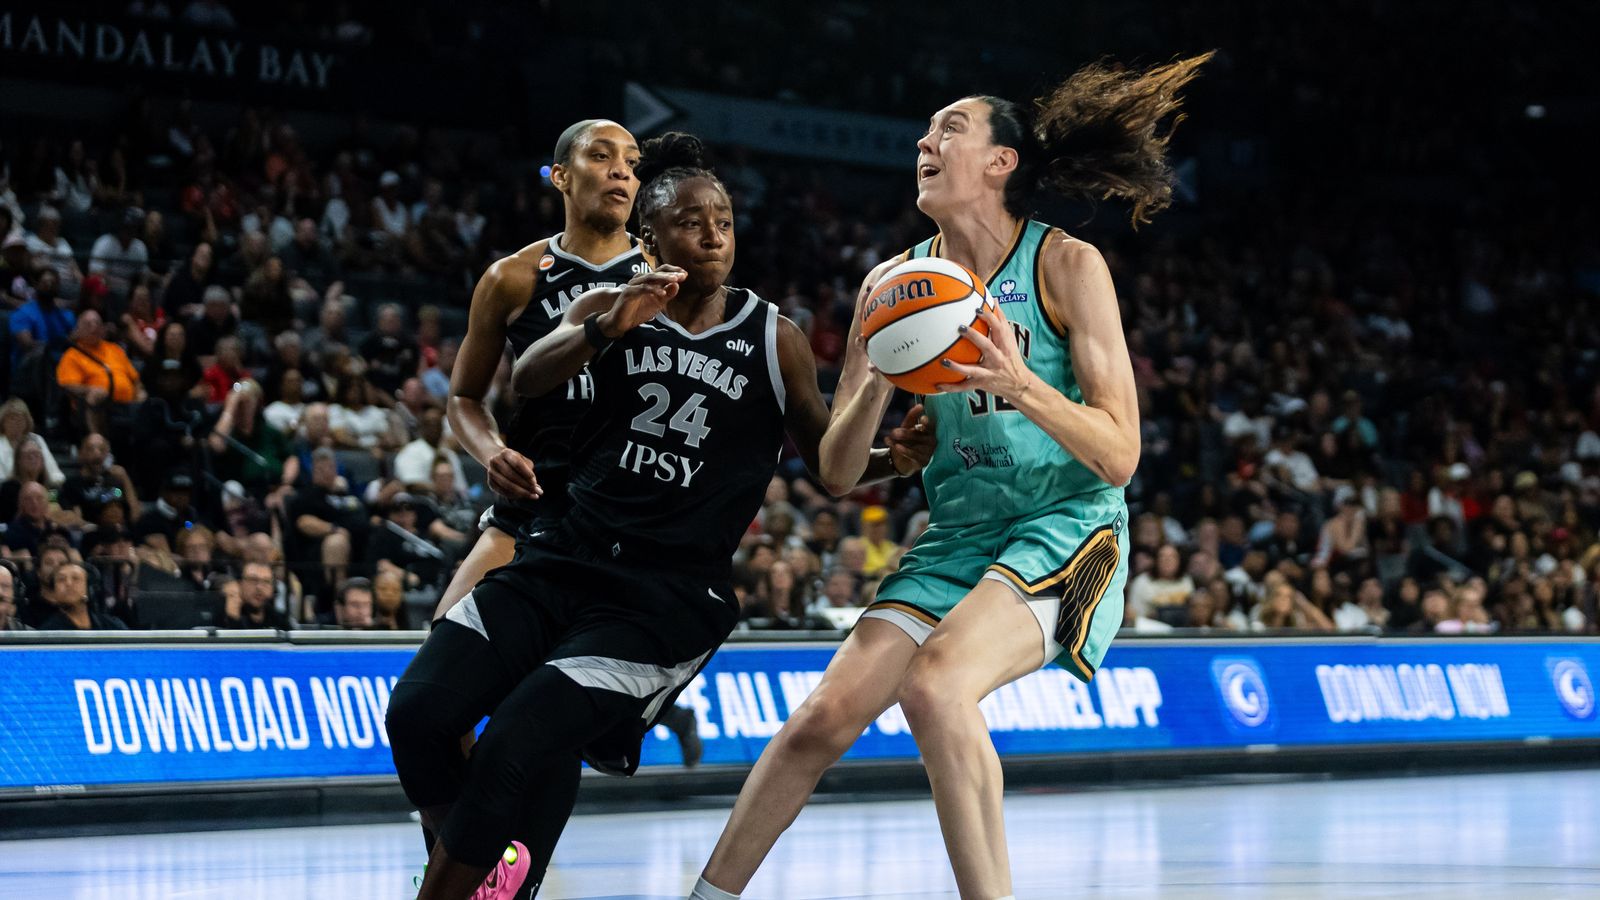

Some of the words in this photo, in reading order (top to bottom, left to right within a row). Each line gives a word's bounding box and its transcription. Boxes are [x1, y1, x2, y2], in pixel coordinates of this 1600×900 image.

[259, 45, 335, 88] BAY
[631, 261, 654, 275] all
[863, 278, 935, 321] Wilson
[996, 294, 1027, 303] RCLAYS
[725, 339, 755, 357] ally
[625, 346, 672, 375] LAS
[677, 348, 749, 400] VEGAS
[630, 382, 711, 448] 24
[618, 440, 704, 488] IPSY
[74, 677, 310, 754] DOWNLOAD
[715, 671, 785, 739] ALL
[1098, 667, 1163, 729] APP
